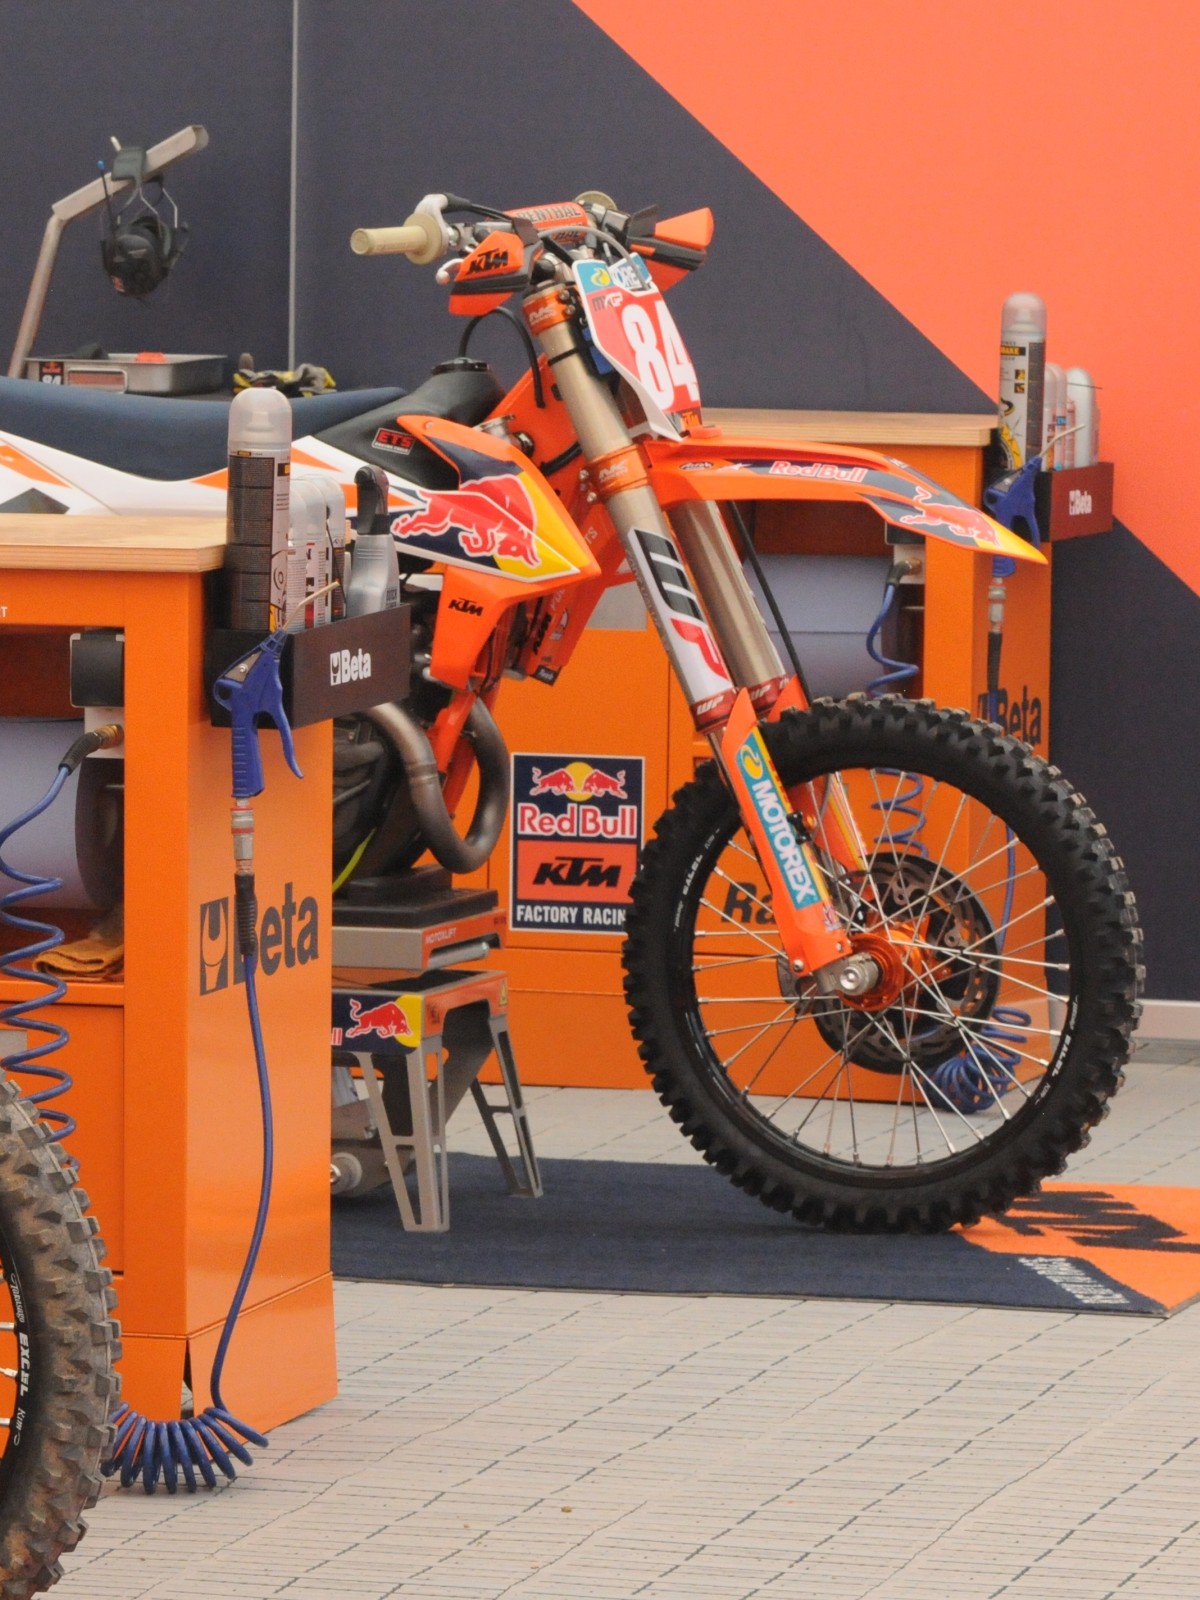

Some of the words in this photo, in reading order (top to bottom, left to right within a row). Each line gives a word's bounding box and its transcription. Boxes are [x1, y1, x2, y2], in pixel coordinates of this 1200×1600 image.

[464, 248, 508, 276] KTM
[622, 301, 700, 411] 84
[377, 430, 413, 448] ETS
[769, 461, 821, 478] Red
[817, 464, 868, 482] Bull
[448, 597, 483, 616] KTM
[341, 648, 372, 683] Beta
[517, 802, 576, 836] Red
[579, 804, 637, 839] Bull
[752, 780, 819, 904] MOTOREX
[533, 856, 621, 888] KTM
[517, 904, 579, 923] FACTORY
[583, 907, 626, 923] RACIN
[19, 1332, 31, 1397] EXCEL
